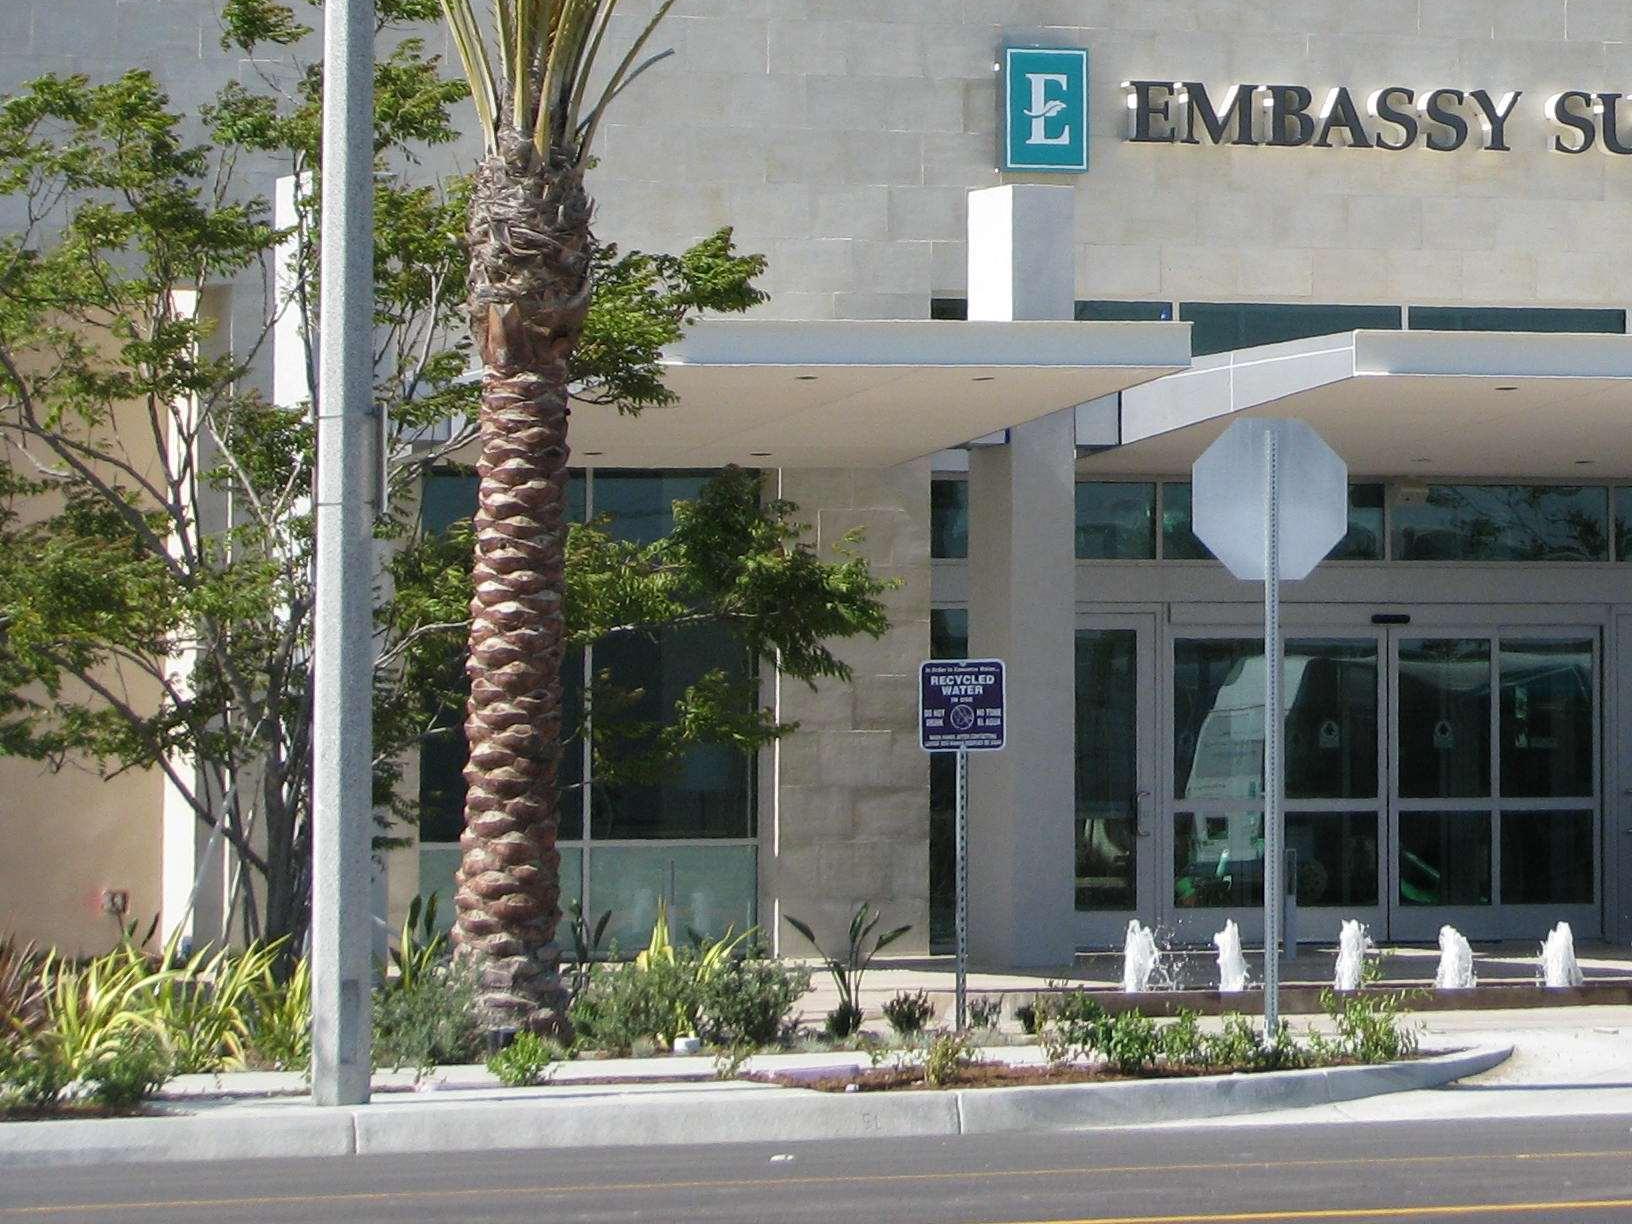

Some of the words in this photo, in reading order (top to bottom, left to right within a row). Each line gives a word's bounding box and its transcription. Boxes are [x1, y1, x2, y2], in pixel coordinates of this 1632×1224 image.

[1124, 80, 1522, 152] EMBASSY
[930, 675, 995, 685] RECYCLED
[941, 686, 983, 695] WATER
